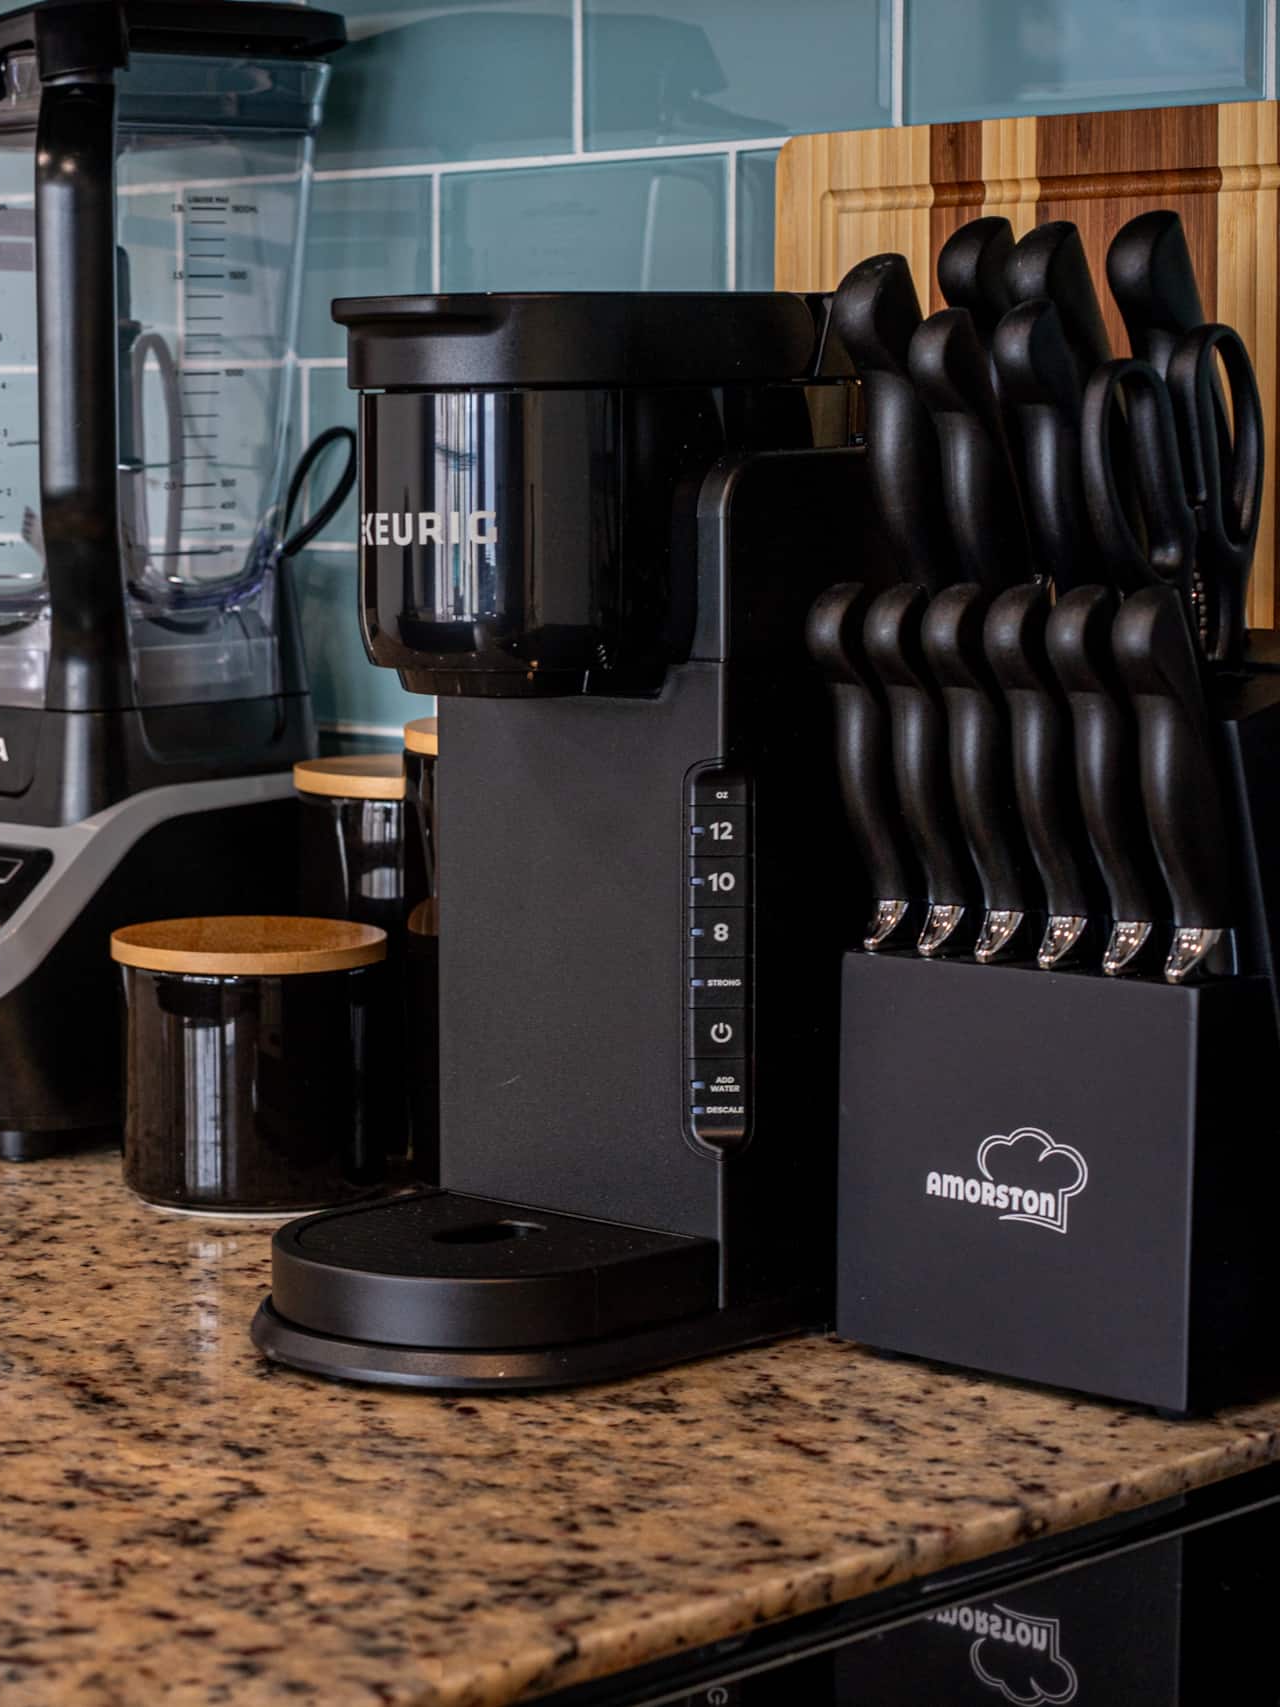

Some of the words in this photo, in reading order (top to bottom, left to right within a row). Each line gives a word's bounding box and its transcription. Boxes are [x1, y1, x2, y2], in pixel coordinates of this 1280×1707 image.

[361, 510, 498, 547] KEURIG
[709, 821, 733, 841] 12
[708, 872, 735, 892] 10
[713, 923, 729, 942] 8
[707, 978, 742, 987] STRONG
[710, 1084, 740, 1093] WATER
[715, 1076, 735, 1085] ADD
[706, 1105, 744, 1115] DESCALE
[926, 1171, 1056, 1219] AMORSTON
